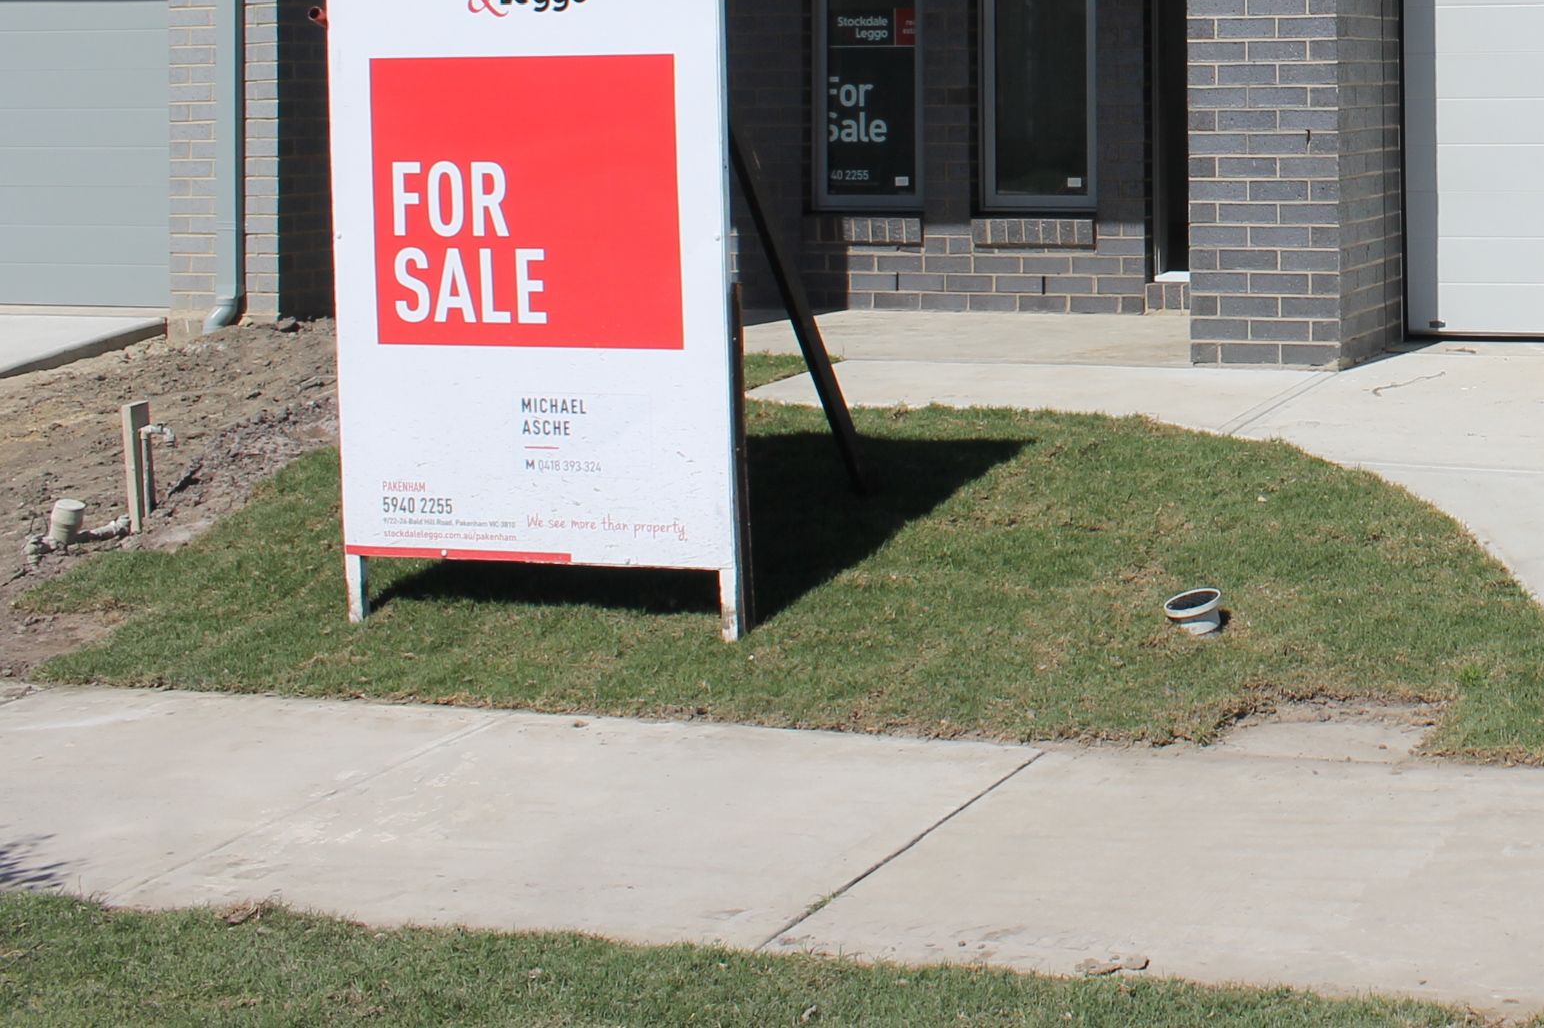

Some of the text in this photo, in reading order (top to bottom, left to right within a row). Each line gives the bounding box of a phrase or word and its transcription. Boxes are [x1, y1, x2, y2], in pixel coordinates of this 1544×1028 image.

[837, 16, 888, 27] Stockdale
[855, 28, 888, 41] Leggo
[830, 169, 869, 181] 40 2255
[392, 160, 510, 238] FOR
[394, 246, 548, 325] SALE
[521, 397, 587, 414] MICHAEL
[522, 419, 571, 436] ASCHE
[525, 459, 602, 473] M 0418 393 324
[382, 481, 426, 492] PAKENHAM
[383, 496, 453, 514] 5940 2255
[455, 519, 488, 527] Pakenham
[527, 513, 543, 528] We
[549, 518, 565, 529] see
[571, 519, 597, 530] more
[601, 513, 629, 532] than
[384, 529, 517, 542] stockdaleleggo.com.au/pakenham
